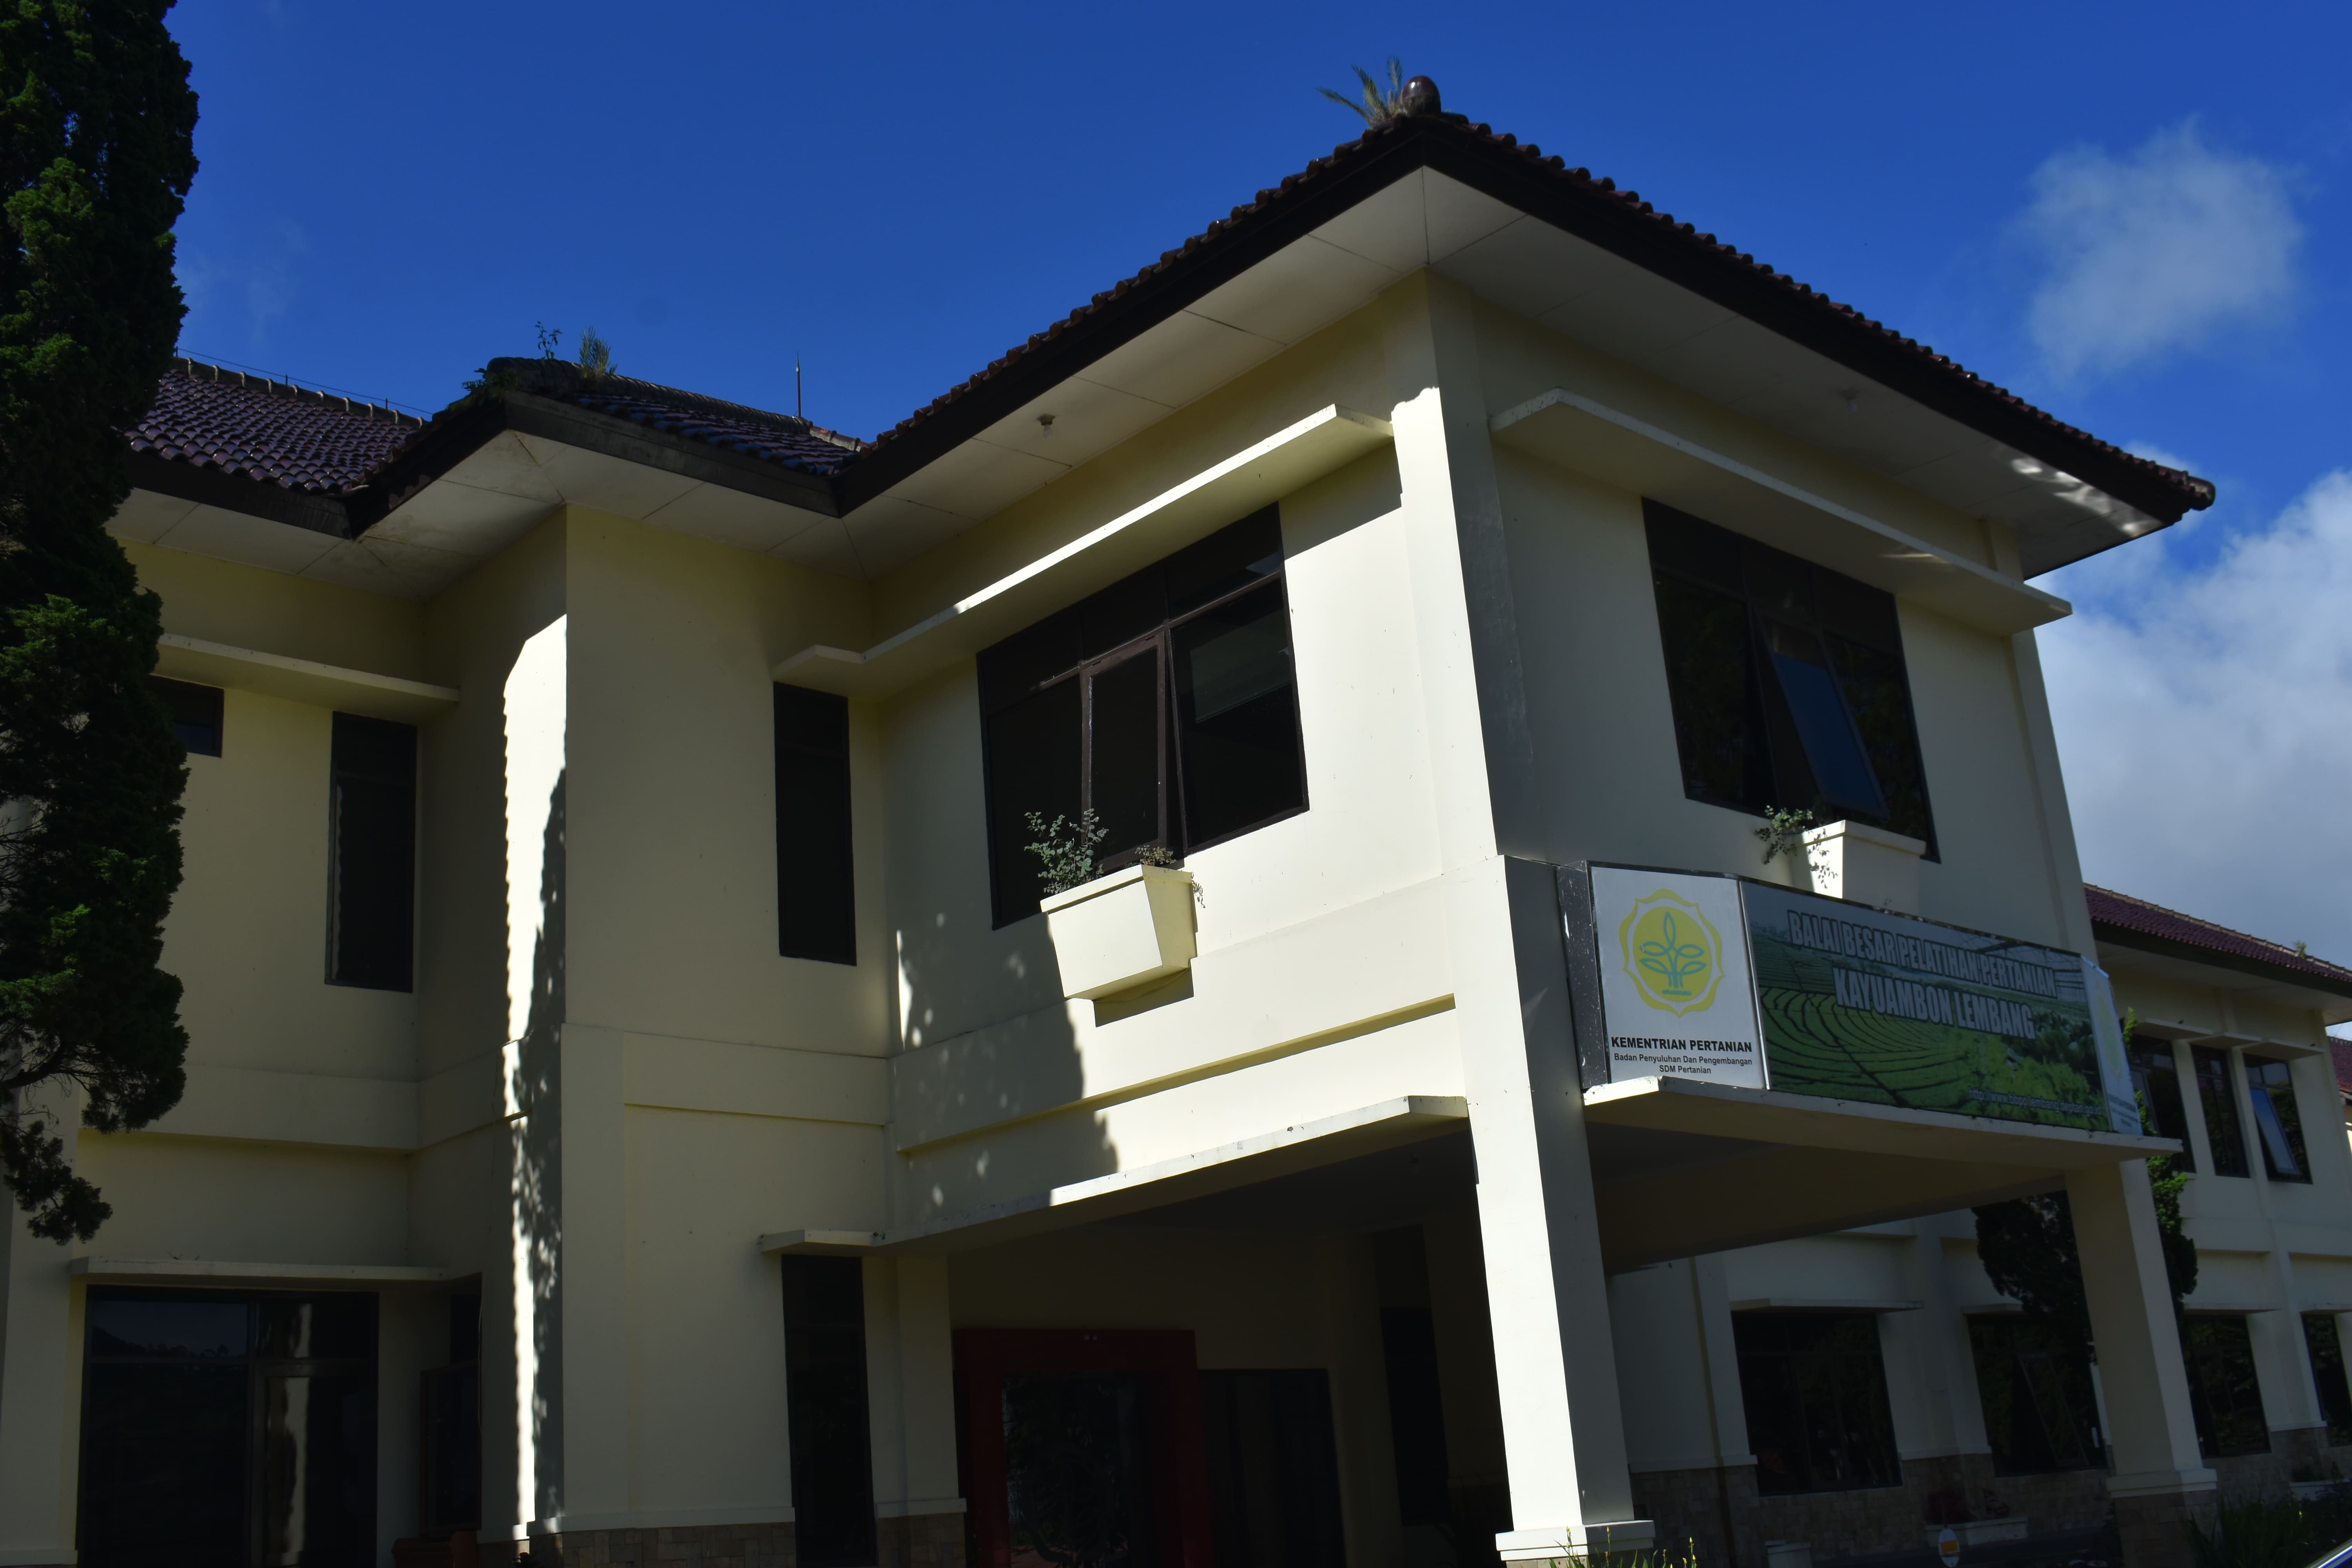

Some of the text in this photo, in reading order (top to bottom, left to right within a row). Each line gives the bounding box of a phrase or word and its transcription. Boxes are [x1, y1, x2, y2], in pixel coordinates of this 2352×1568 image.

[1787, 909, 2058, 998] BALAI BESAR PELATIHAN PERTANIAN
[1833, 967, 2036, 1040] KAYUAMBON LEMBANG
[1611, 1037, 1752, 1052] KEMENTRIAN PERTANIAN
[1639, 1054, 1681, 1063] Penyuluhan
[1699, 1056, 1752, 1066] Pengembangan
[1678, 1065, 1711, 1074] Pertanian
